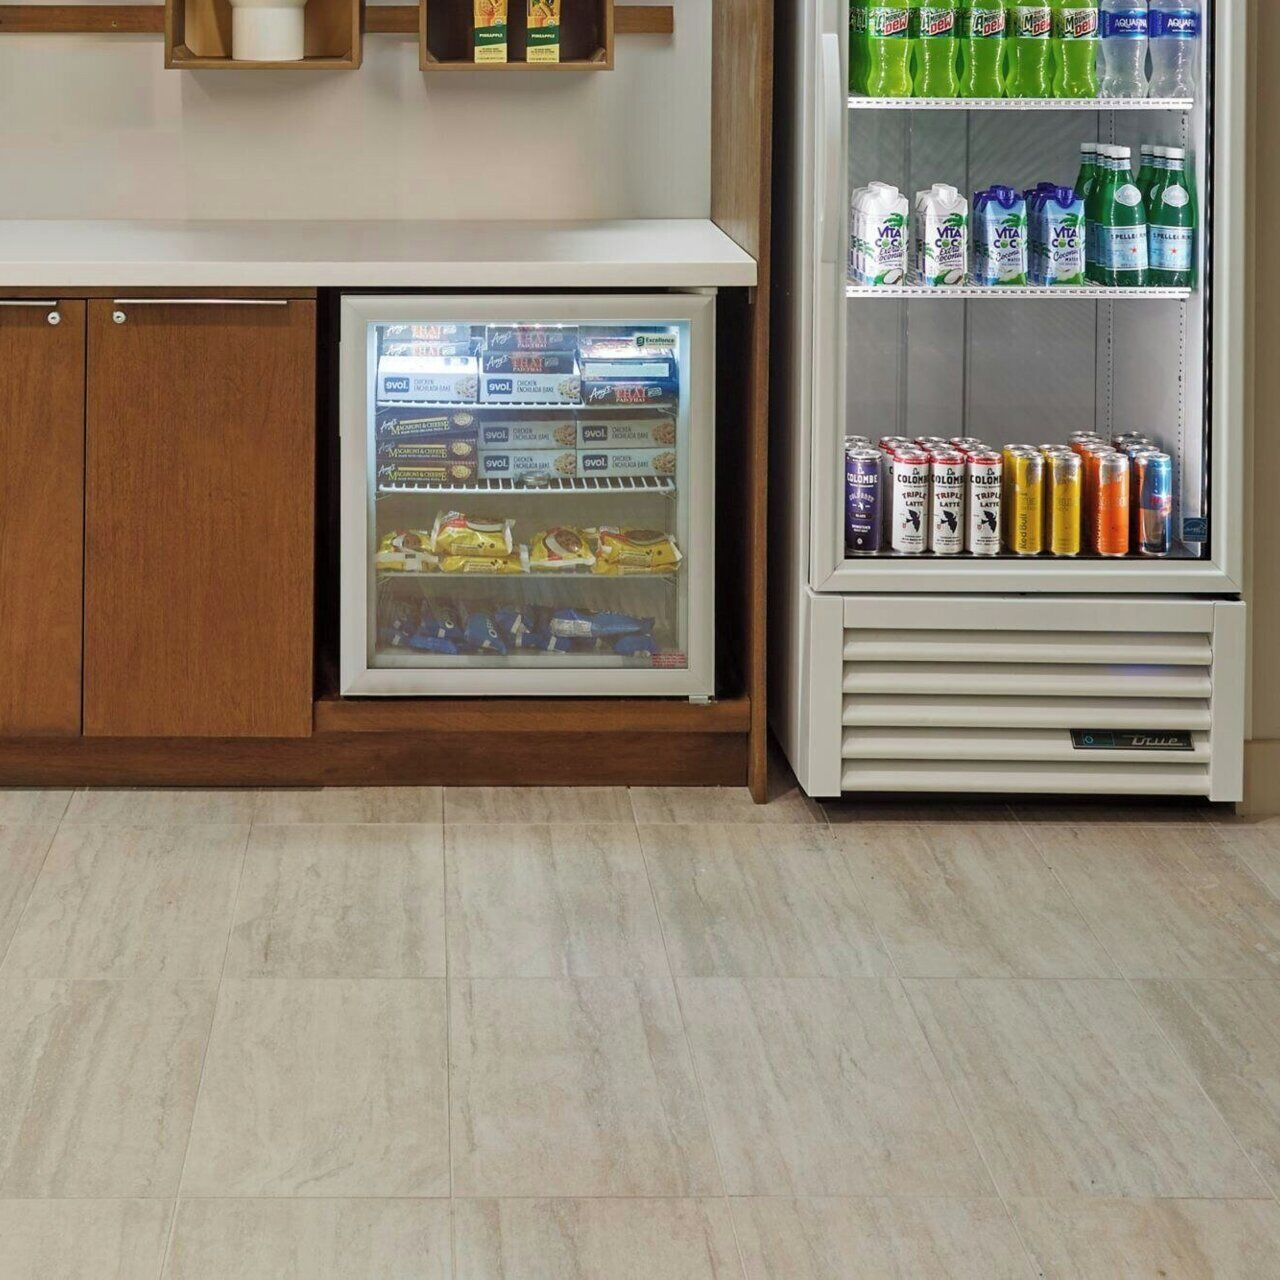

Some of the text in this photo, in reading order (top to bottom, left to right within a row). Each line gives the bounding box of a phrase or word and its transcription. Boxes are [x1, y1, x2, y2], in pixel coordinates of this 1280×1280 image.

[878, 227, 901, 238] VITA
[937, 227, 961, 238] VITA
[995, 227, 1020, 238] VITA
[1054, 228, 1077, 238] VITA
[585, 458, 607, 466] evol.
[847, 473, 878, 484] COLOMBE
